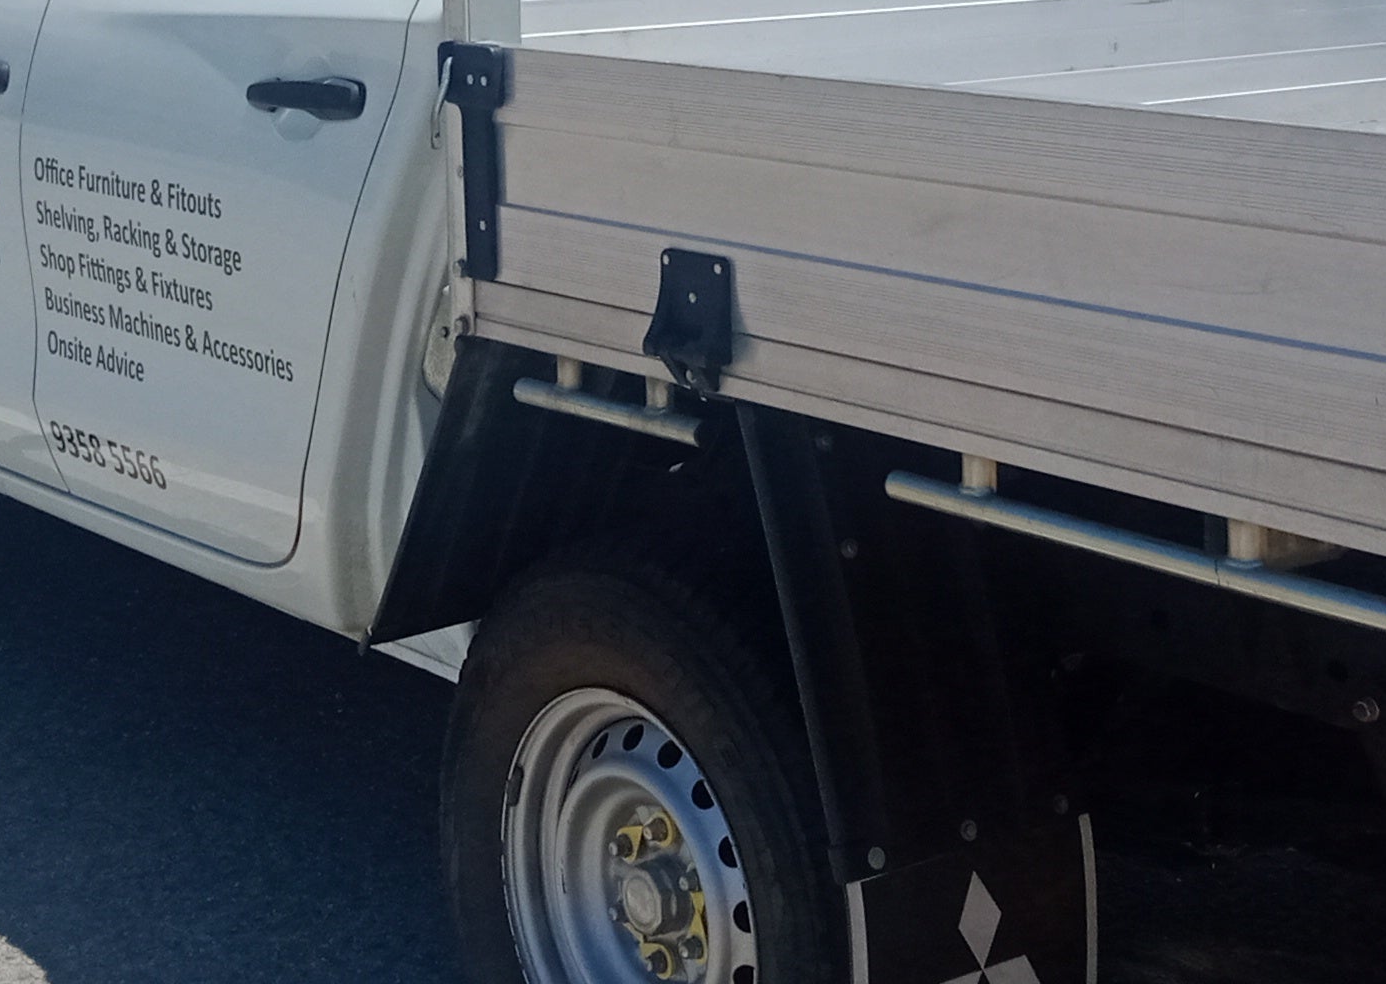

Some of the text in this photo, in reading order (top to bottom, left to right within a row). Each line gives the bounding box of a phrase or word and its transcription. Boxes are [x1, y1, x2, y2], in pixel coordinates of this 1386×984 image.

[34, 157, 222, 220] Office Furniture & Fitouts
[36, 200, 242, 274] Shelving, Racking & Storage
[40, 244, 213, 312] Shop Fittings & Fixtures
[44, 287, 293, 382] Business Machines & Accessories
[47, 331, 145, 383] Onsite Advice
[50, 420, 167, 490] 9358 5566
